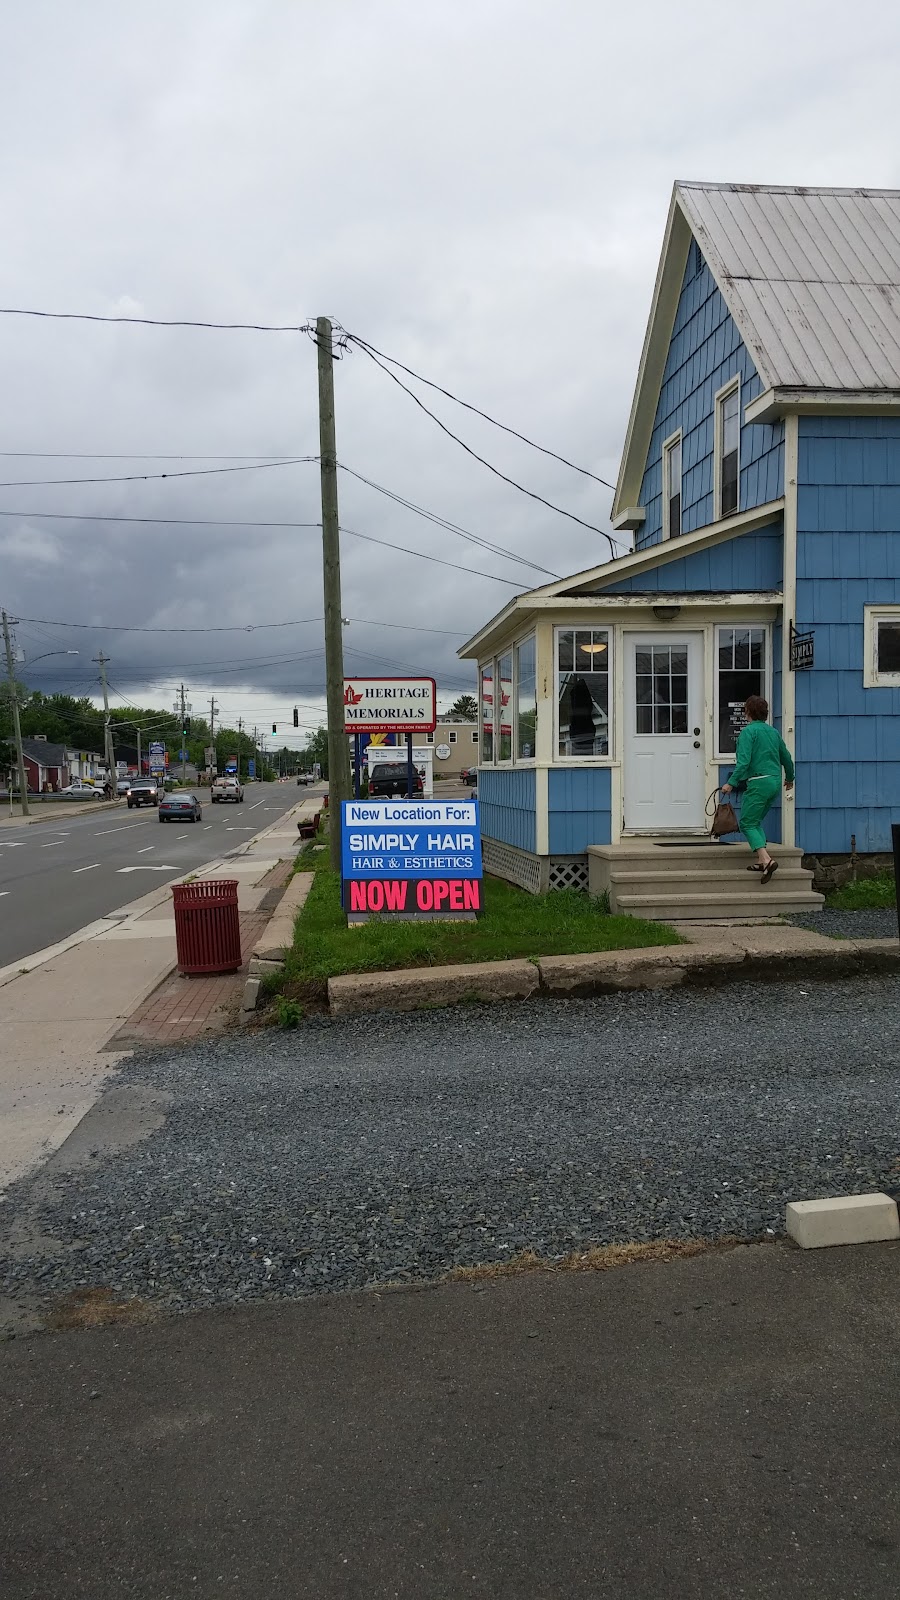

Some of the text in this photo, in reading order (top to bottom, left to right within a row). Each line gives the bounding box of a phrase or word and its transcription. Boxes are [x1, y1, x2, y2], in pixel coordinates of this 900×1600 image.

[792, 643, 813, 659] SIMPLY
[365, 688, 430, 698] HERITAGE
[346, 708, 425, 719] MEMORIALS
[351, 806, 470, 820] New Location For:
[349, 834, 474, 851] SIMPLY HAIR
[352, 857, 473, 869] HAIR & ESTHETICS
[350, 880, 480, 911] NOW OPEN
